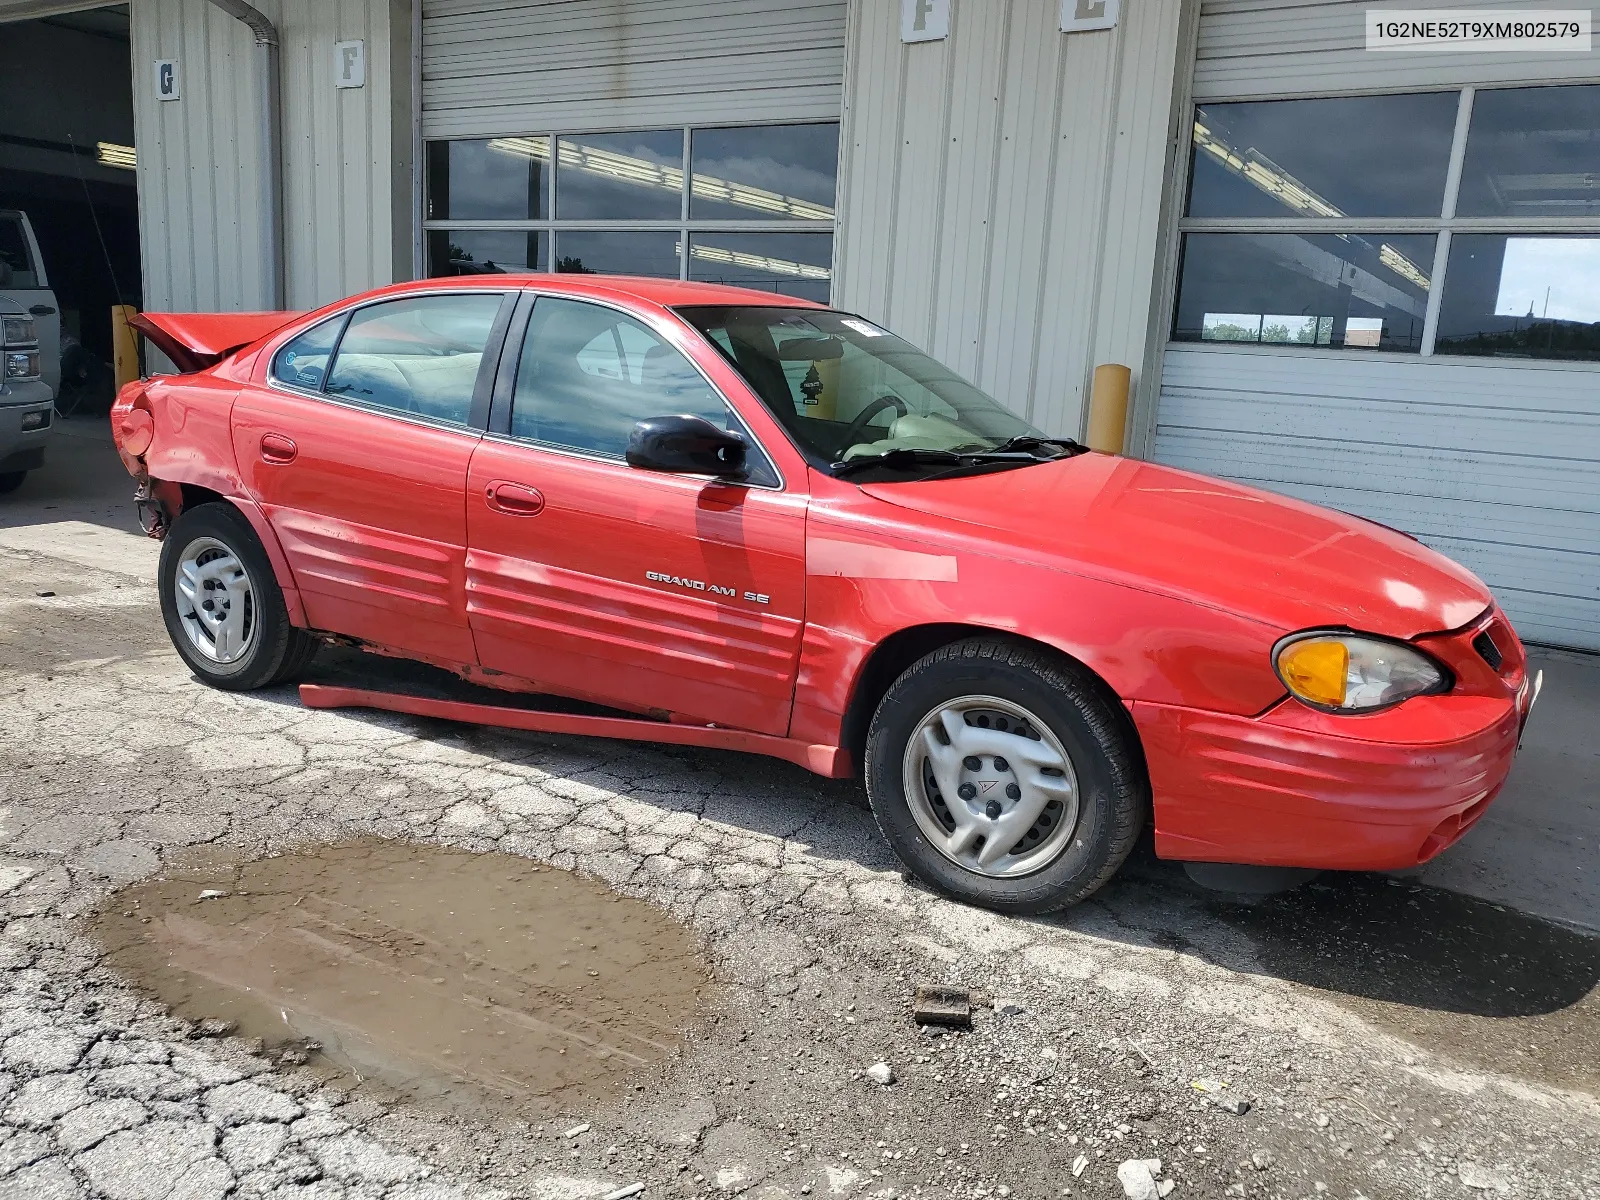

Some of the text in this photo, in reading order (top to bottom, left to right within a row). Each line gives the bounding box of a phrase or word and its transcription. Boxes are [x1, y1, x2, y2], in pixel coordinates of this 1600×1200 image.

[160, 63, 174, 95] G
[342, 47, 358, 80] F
[645, 570, 770, 604] GRAND AM SE
